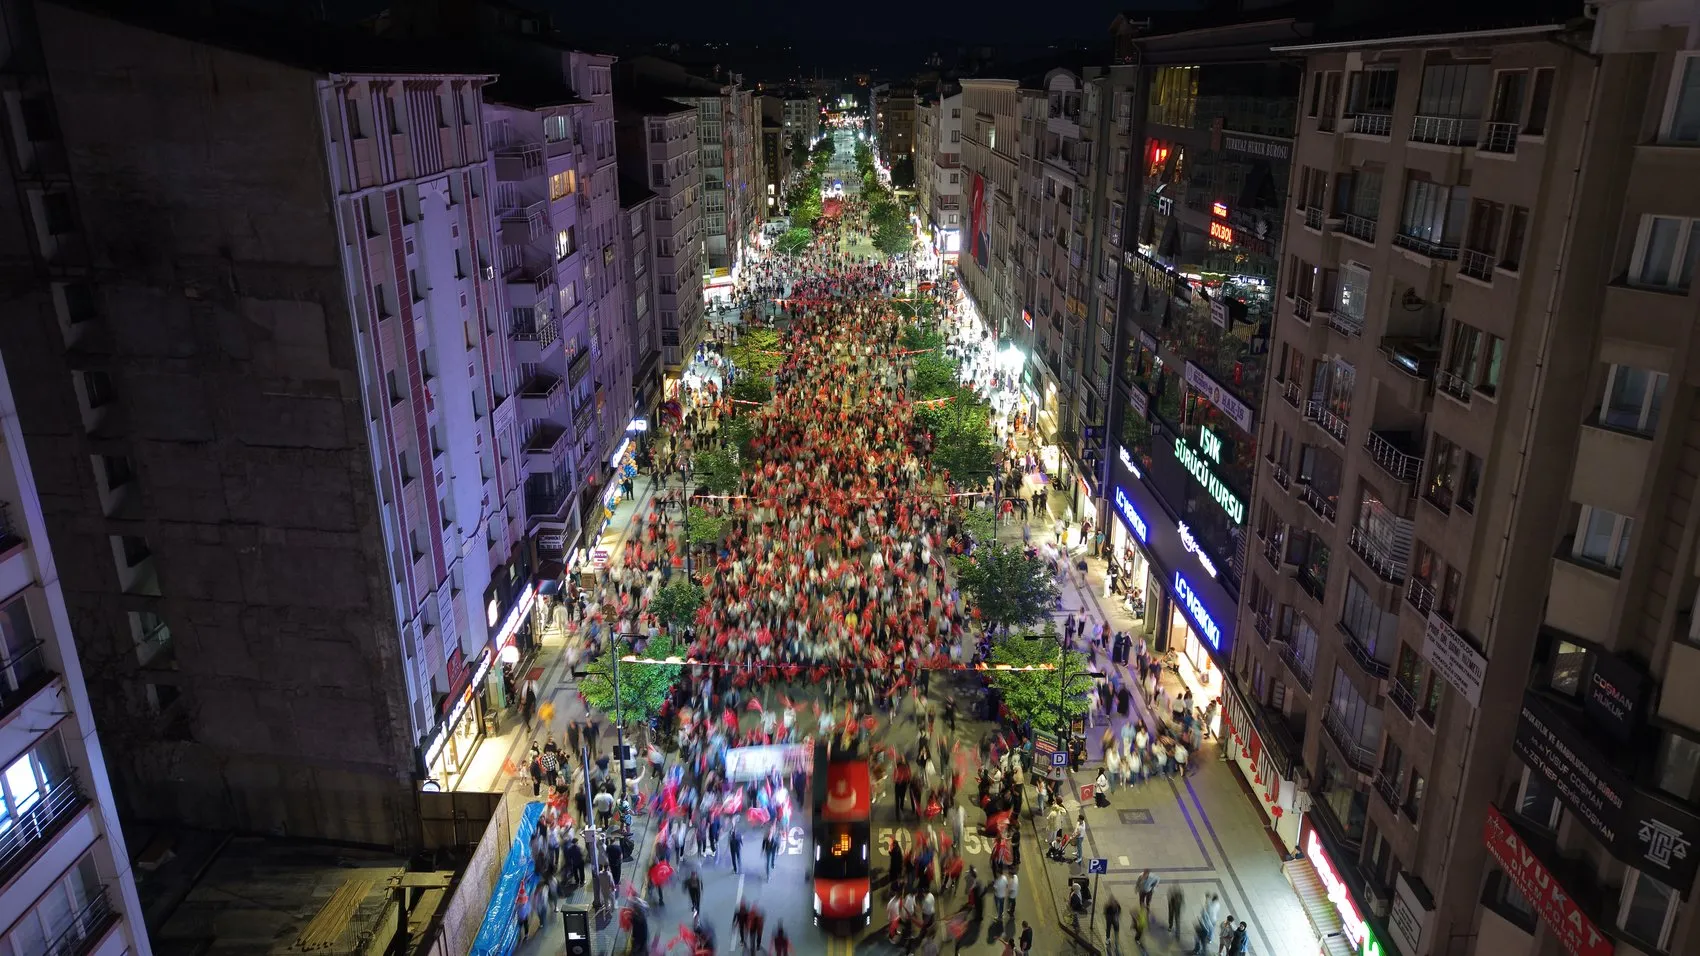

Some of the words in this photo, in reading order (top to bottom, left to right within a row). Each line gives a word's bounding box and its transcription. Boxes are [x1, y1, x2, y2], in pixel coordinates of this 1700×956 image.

[1211, 222, 1232, 242] BOLBOL
[1200, 424, 1222, 464] IŞIK
[1116, 486, 1124, 508] LC
[1174, 438, 1208, 487] SÜRÜCÜ
[1208, 473, 1243, 524] KURSU
[1175, 571, 1187, 598] LC
[1593, 672, 1633, 711] COSMAN
[1594, 689, 1625, 720] HUKUK
[1056, 754, 1063, 763] D
[1522, 707, 1549, 737] AVUKATLIK
[1548, 731, 1556, 744] VE
[1555, 739, 1598, 786] ARABULUCULUK
[1598, 773, 1623, 809] BÜROSU
[1570, 769, 1604, 811] COSMAN
[1557, 777, 1579, 808] DEMİR
[1579, 803, 1615, 843] COSMAN
[1090, 859, 1099, 870] P
[1506, 835, 1602, 948] AVUKAT
[1511, 858, 1542, 901] DİLEM
[1546, 901, 1582, 948] POLAT
